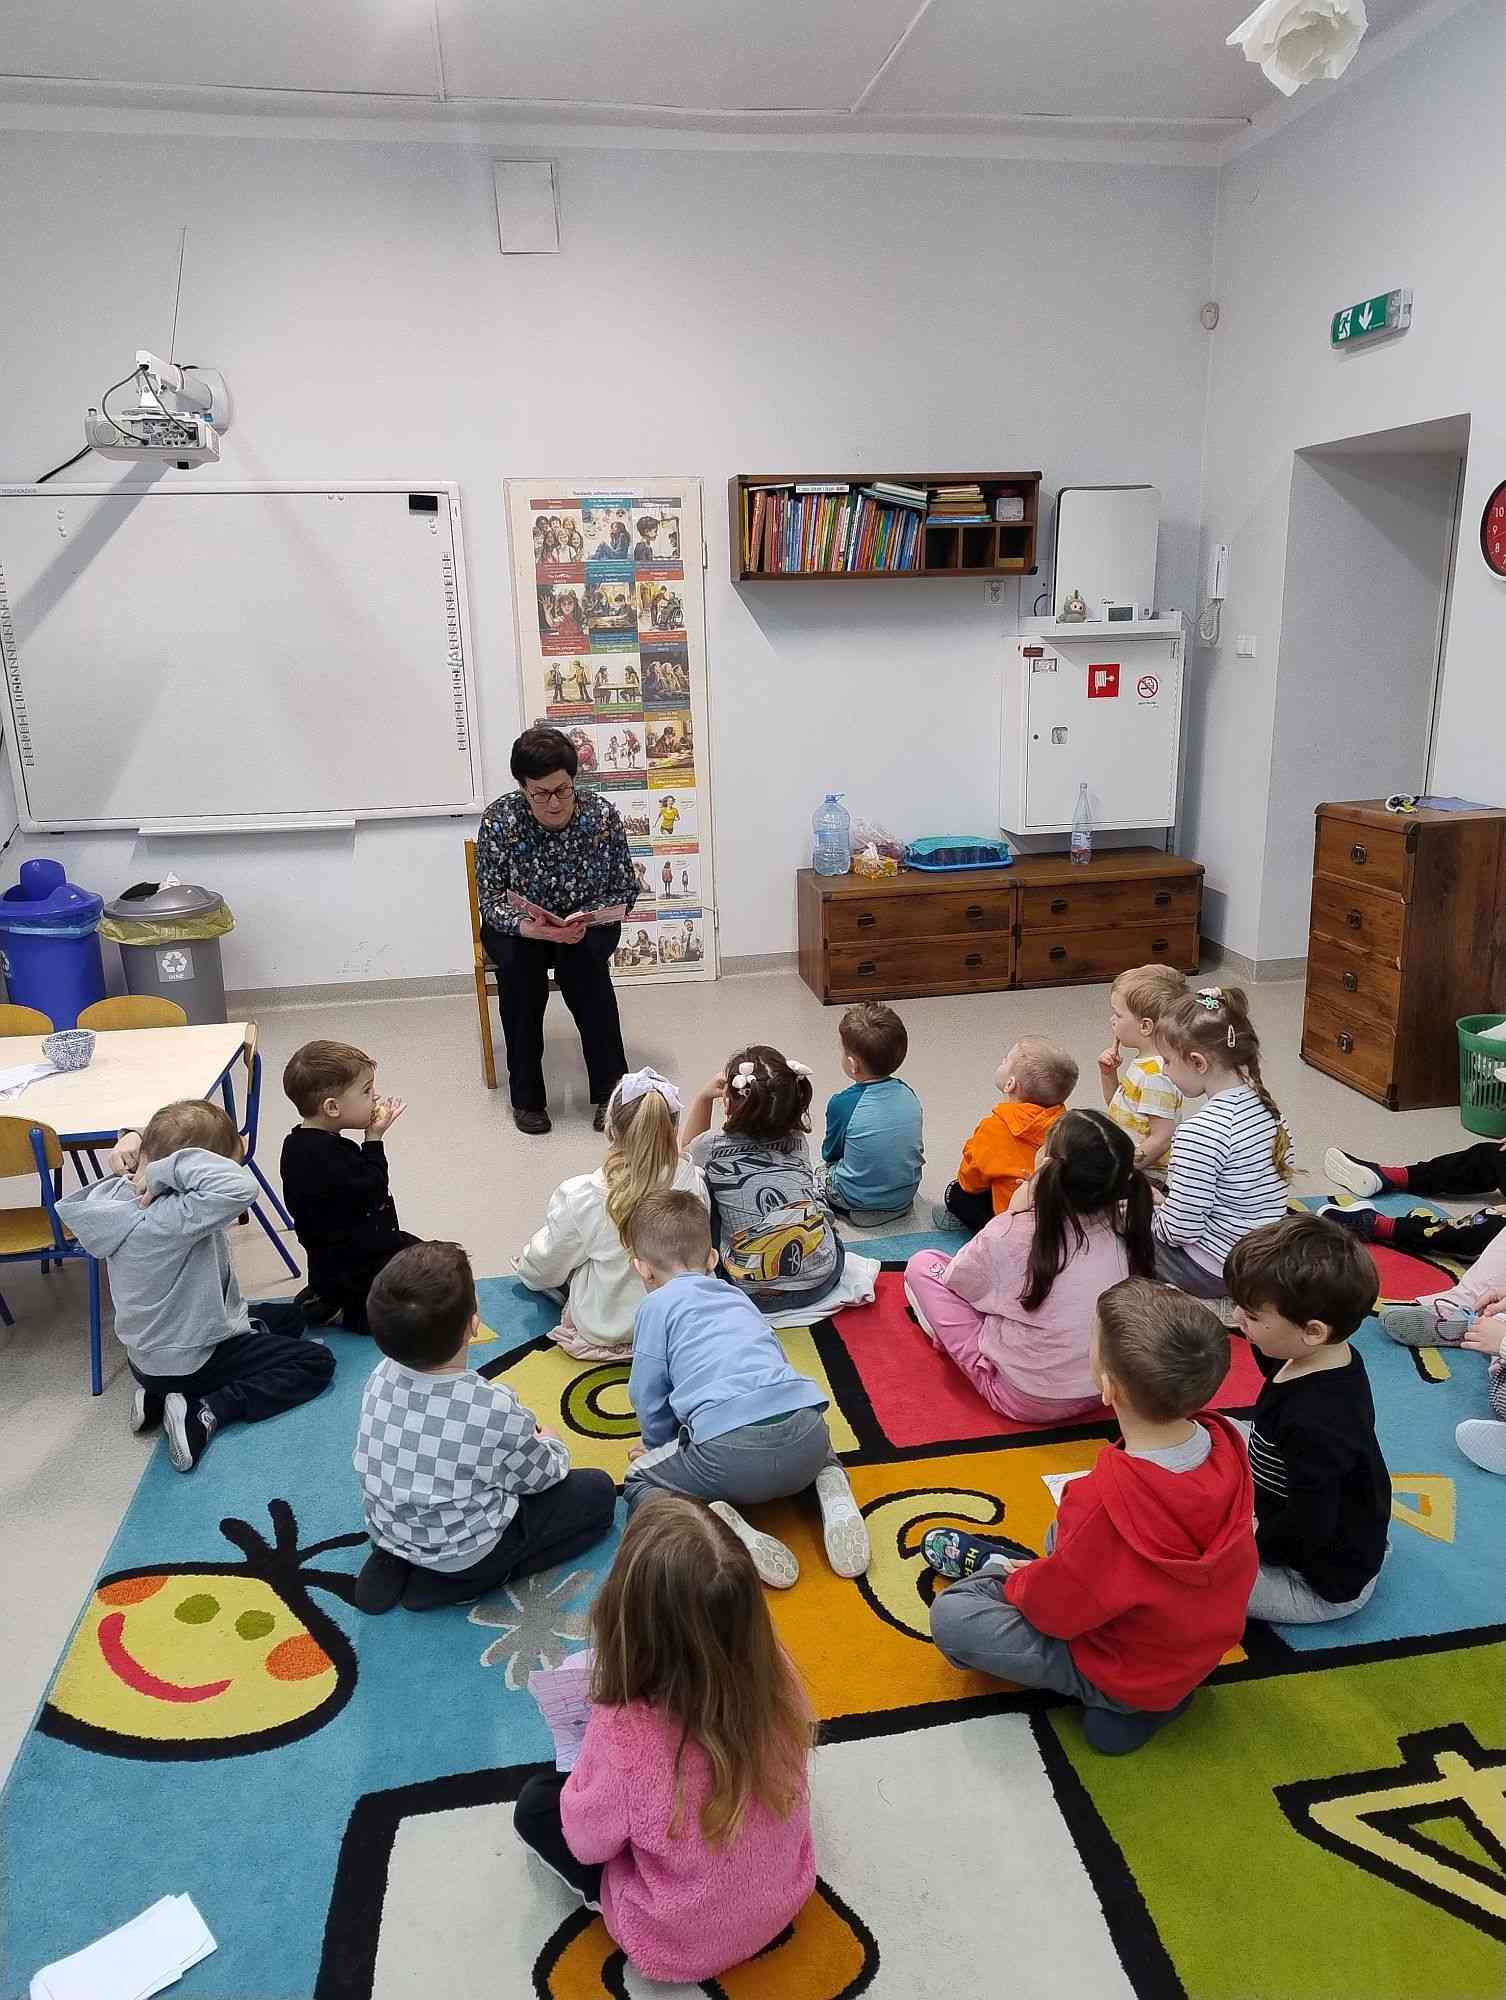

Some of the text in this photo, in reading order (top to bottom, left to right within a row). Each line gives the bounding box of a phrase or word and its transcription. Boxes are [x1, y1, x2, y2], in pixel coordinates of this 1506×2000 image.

[1495, 506, 1505, 518] 10
[1492, 524, 1498, 536] 9
[1495, 542, 1500, 553] 8
